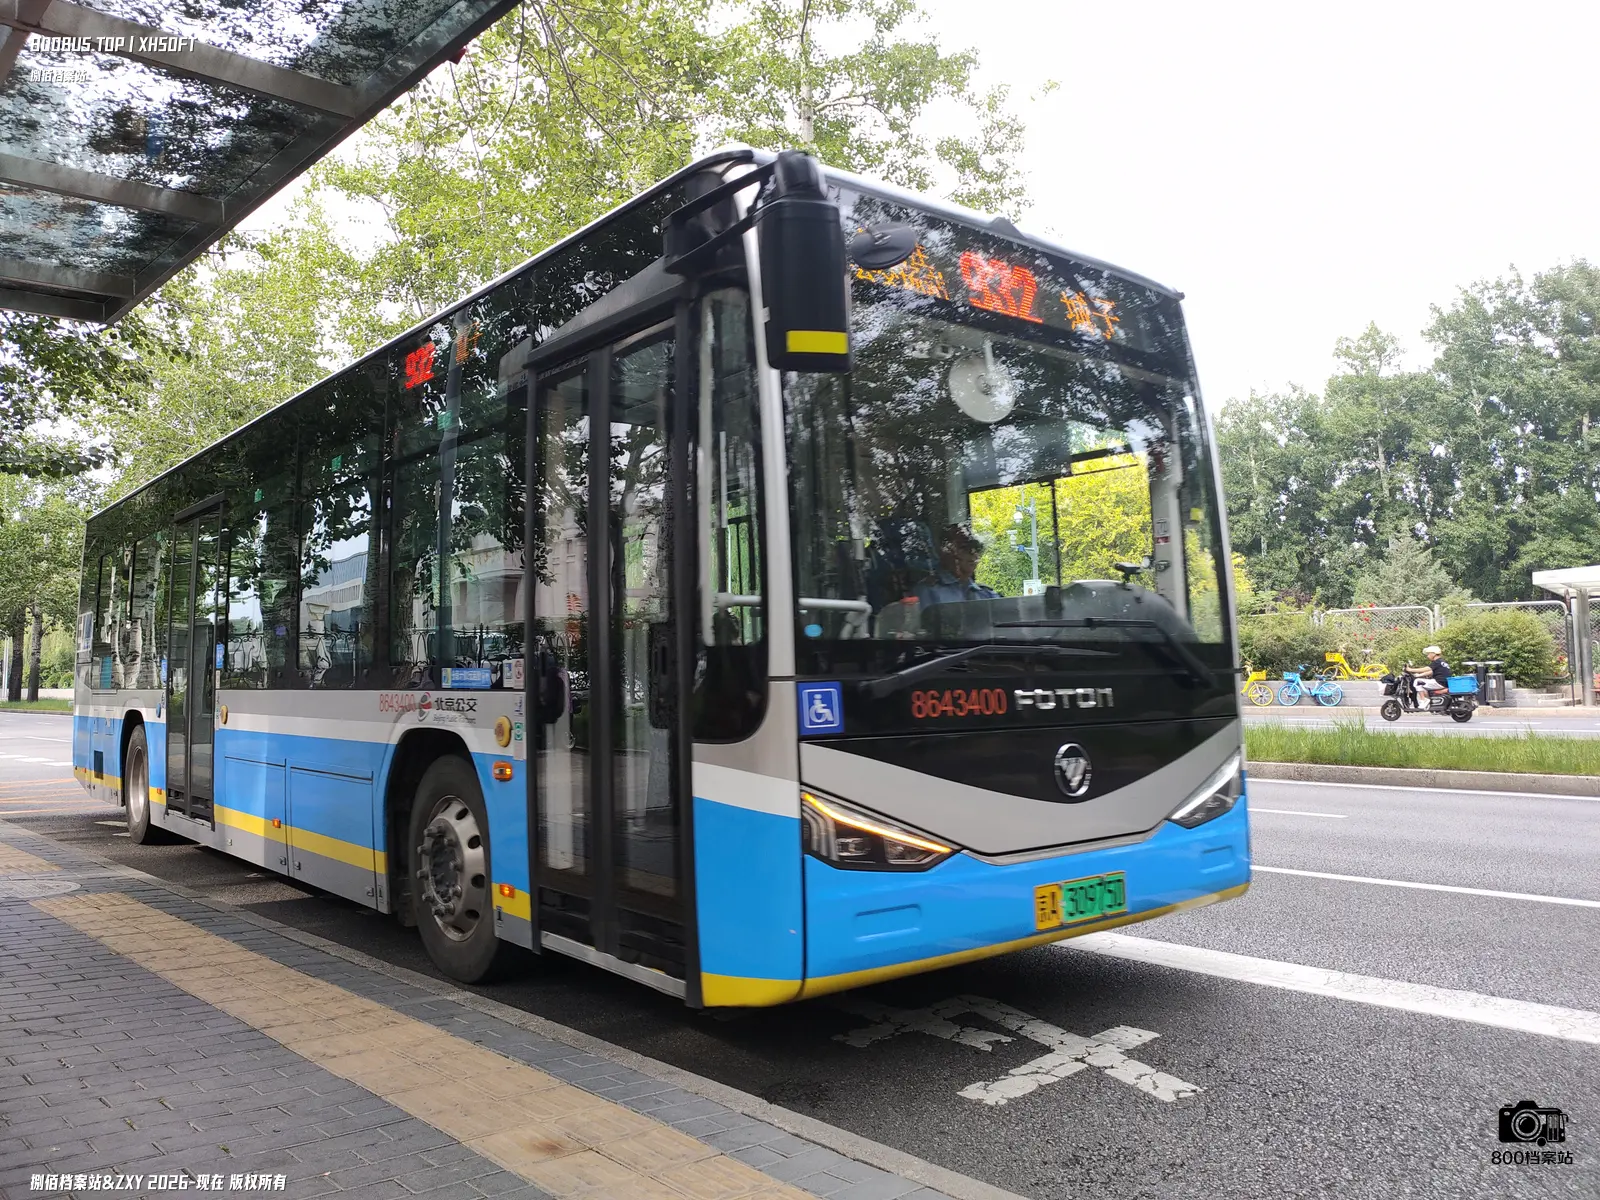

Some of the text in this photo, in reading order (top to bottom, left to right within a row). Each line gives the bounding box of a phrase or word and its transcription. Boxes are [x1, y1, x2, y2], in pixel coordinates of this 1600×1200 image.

[379, 693, 417, 713] 8643400
[435, 697, 478, 713] 北京公交
[911, 688, 1008, 719] 8643400
